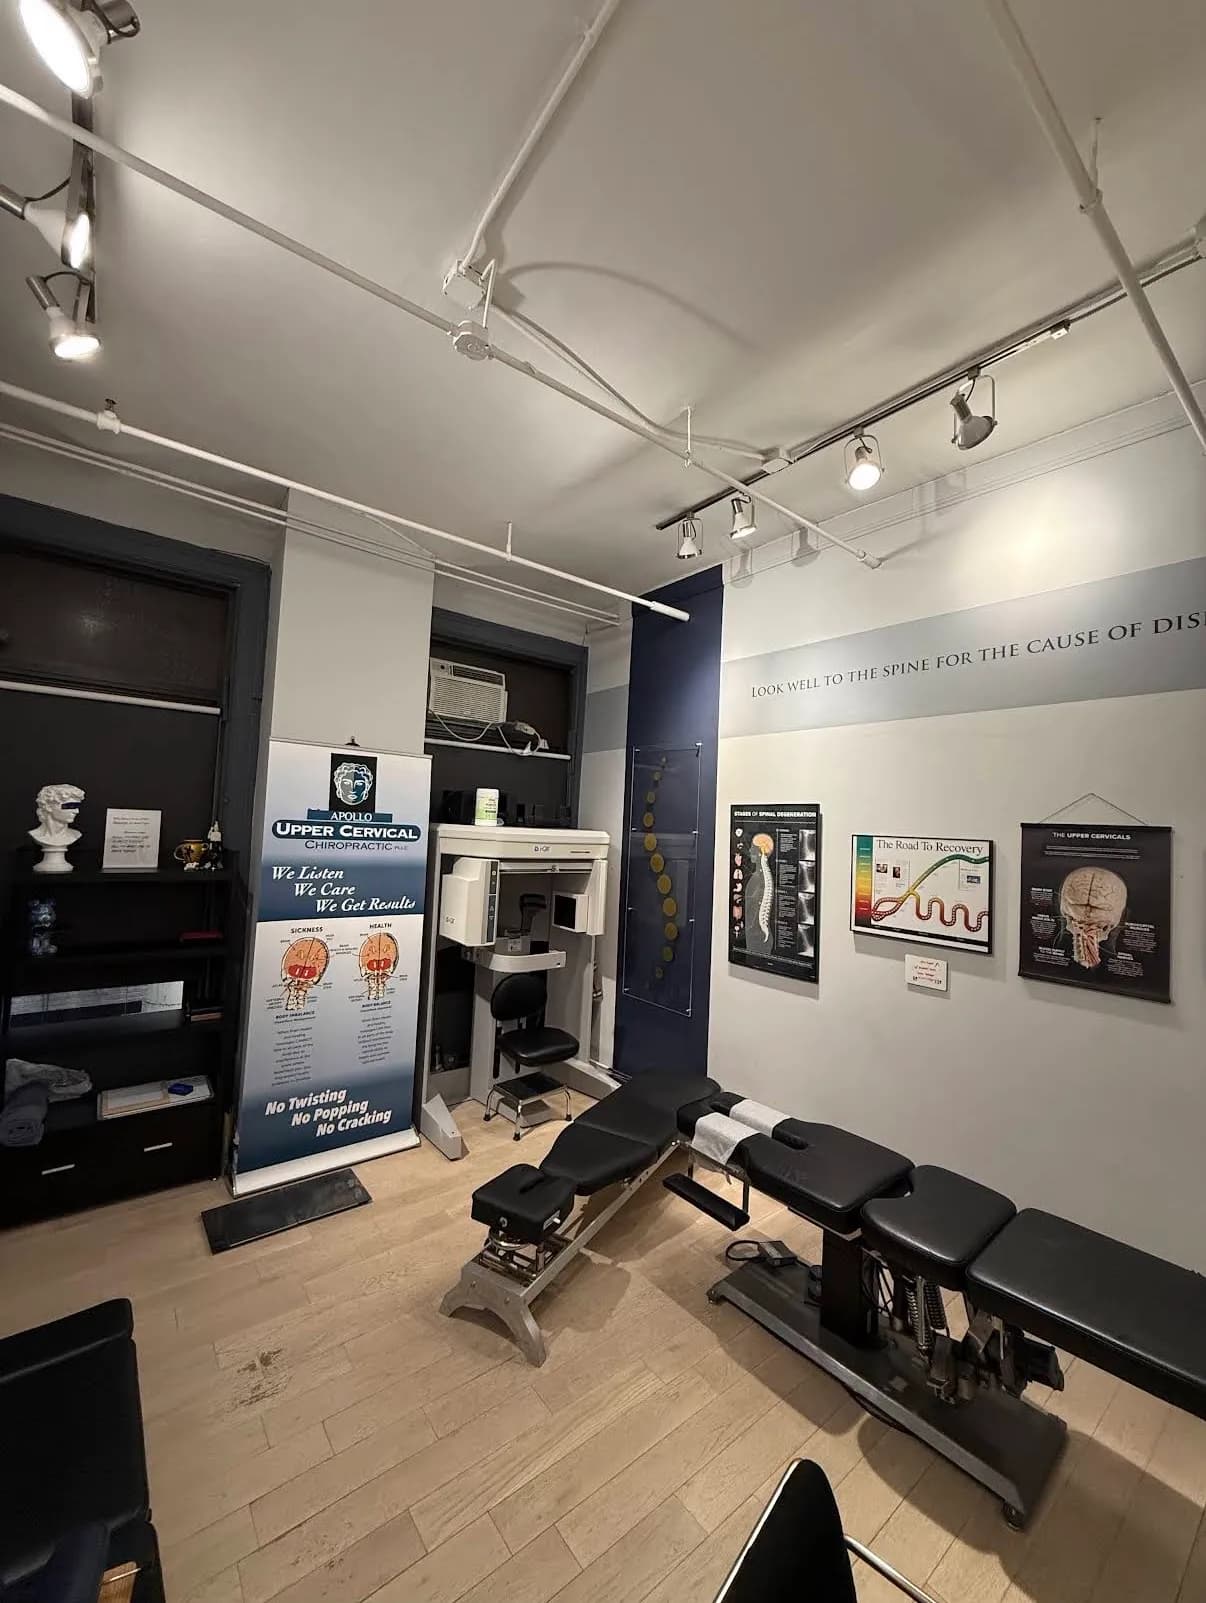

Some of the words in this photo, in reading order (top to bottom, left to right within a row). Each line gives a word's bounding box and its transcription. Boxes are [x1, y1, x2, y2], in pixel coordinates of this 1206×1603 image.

[751, 684, 784, 698] LOOK
[787, 677, 821, 693] WELL
[824, 673, 843, 687] TO
[847, 667, 878, 683] THE
[882, 658, 929, 678] SPINE
[936, 651, 973, 669] FOR
[979, 643, 1020, 662] THE
[1026, 629, 1100, 654] CAUSE
[1107, 622, 1143, 641] OF
[1152, 610, 1206, 635] DIS
[330, 811, 373, 822] APOLLO
[276, 822, 335, 837] UPPER
[340, 825, 418, 839] CERVICAL
[304, 840, 393, 851] CHIROPRACTIC
[876, 839, 893, 850] The
[895, 841, 919, 850] Road
[920, 842, 934, 851] To
[936, 843, 983, 855] Recovery
[272, 866, 295, 880] We
[297, 866, 344, 880] Listen
[294, 882, 317, 896] We
[320, 882, 356, 896] Care
[316, 899, 338, 912] We
[341, 898, 367, 912] Get
[367, 896, 416, 911] Results
[290, 926, 323, 934] SICKNESS
[265, 1101, 286, 1116] No
[289, 1089, 347, 1111] Twisting
[291, 1112, 311, 1127] No
[313, 1100, 369, 1122] Popping
[316, 1123, 335, 1137] No
[337, 1110, 392, 1132] Cracking
